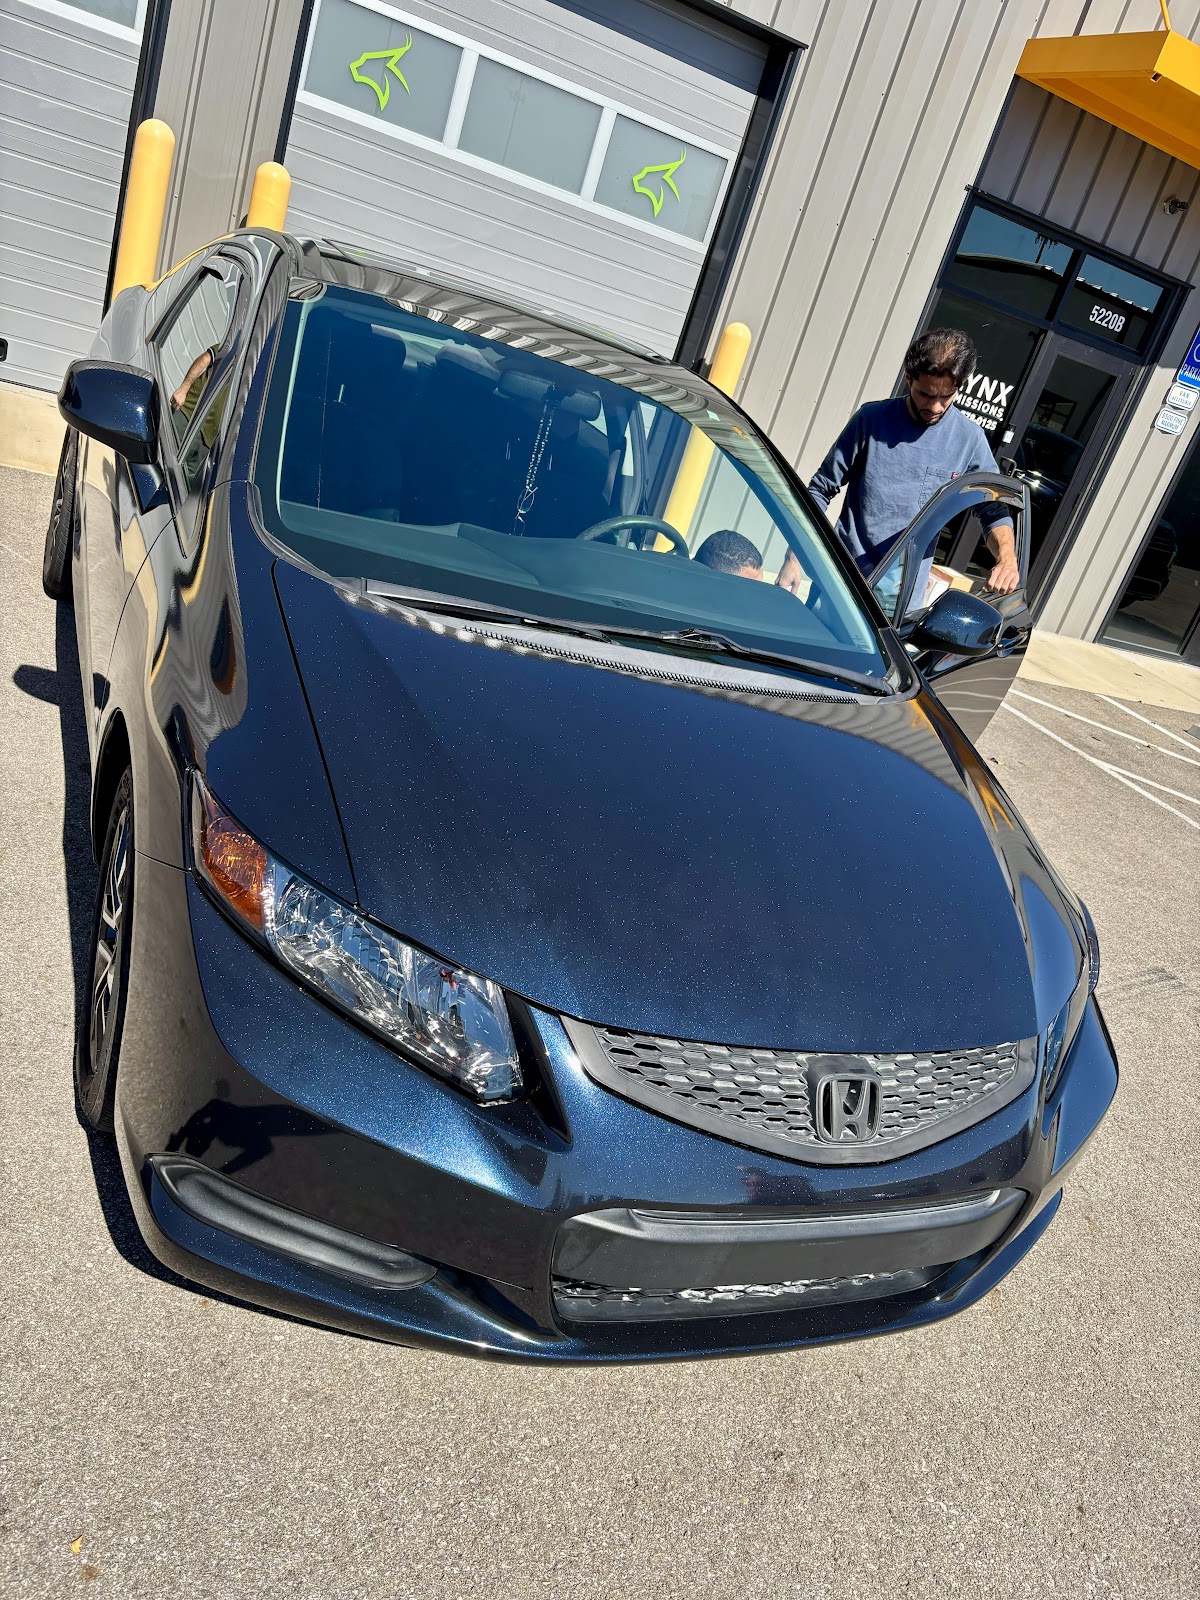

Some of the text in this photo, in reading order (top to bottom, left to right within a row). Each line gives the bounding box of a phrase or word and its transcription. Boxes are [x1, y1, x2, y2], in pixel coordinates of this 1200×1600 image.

[1089, 305, 1126, 333] 5220B
[959, 373, 1014, 407] YNX
[1180, 391, 1190, 399] VAN
